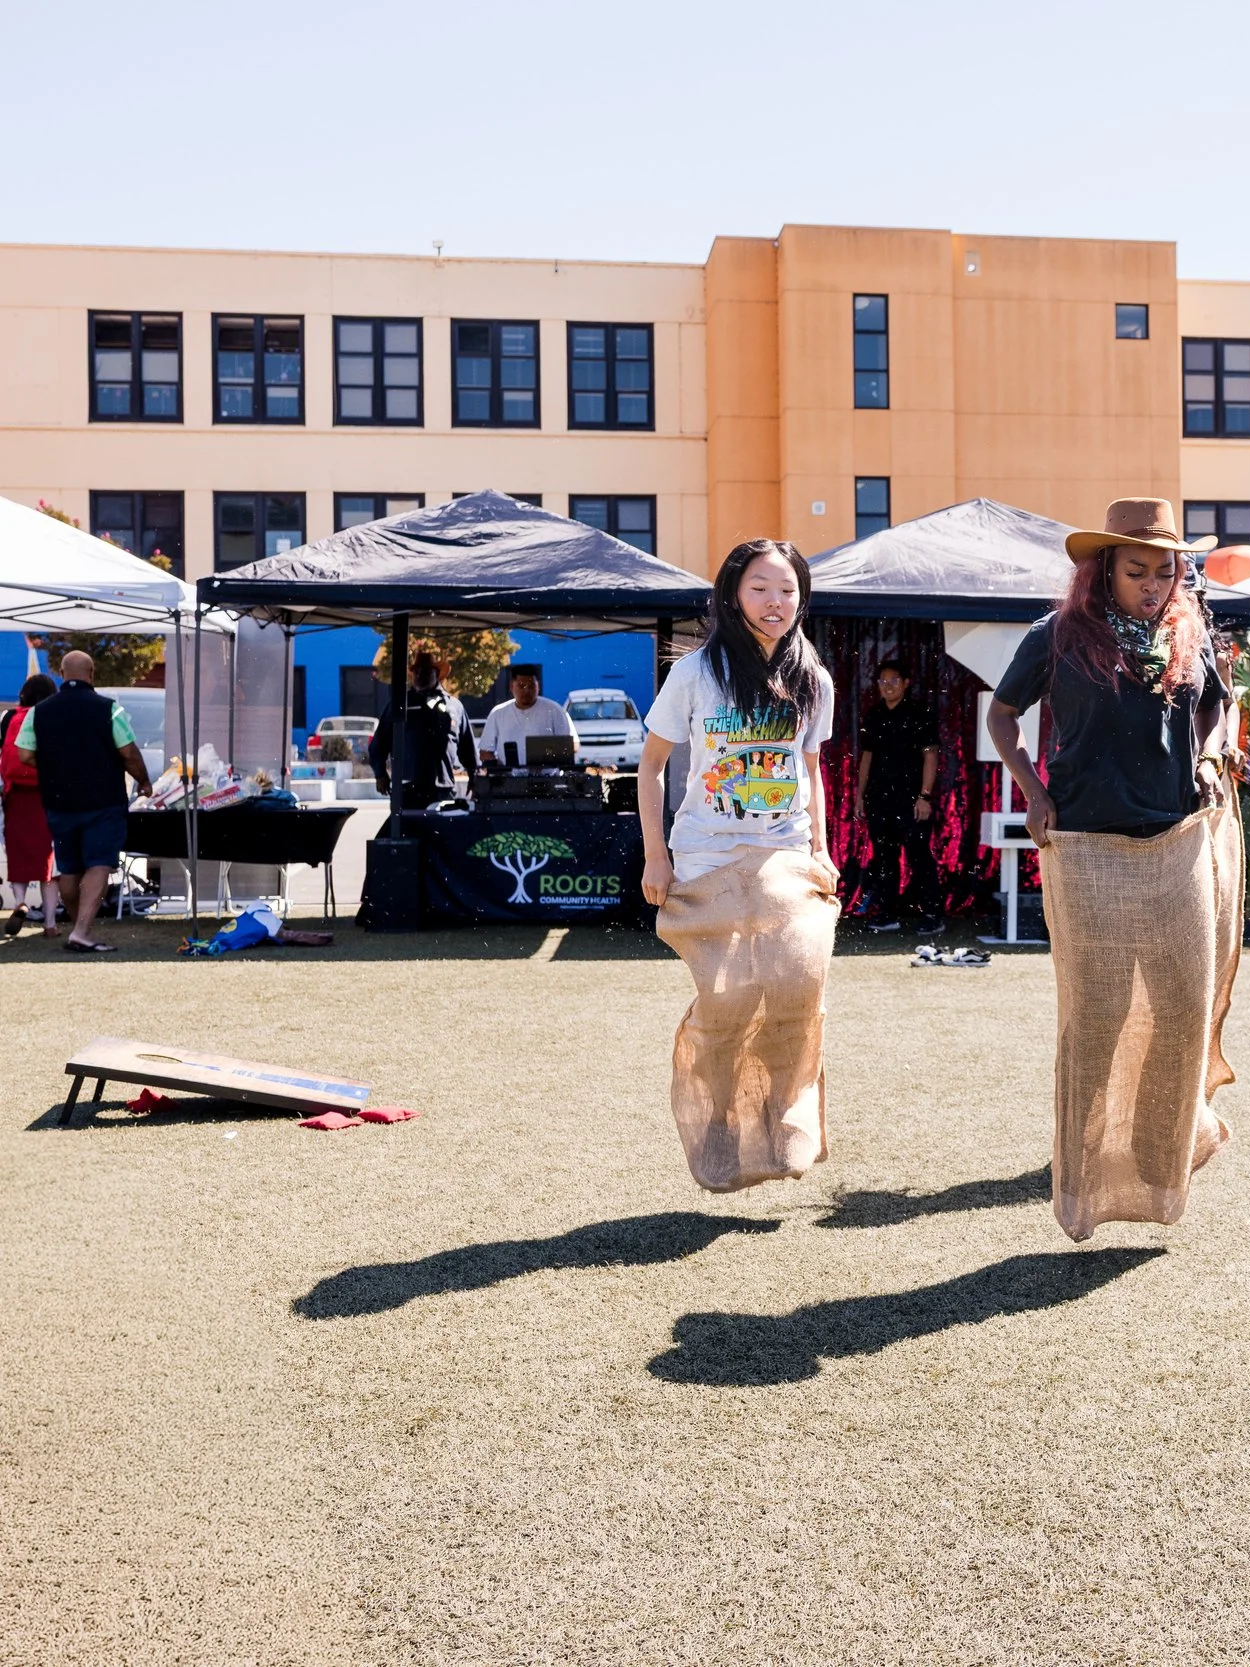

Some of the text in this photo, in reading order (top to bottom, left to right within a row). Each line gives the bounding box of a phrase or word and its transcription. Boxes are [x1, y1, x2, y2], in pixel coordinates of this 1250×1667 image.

[704, 717, 730, 733] THE
[540, 874, 620, 894] ROOTS
[540, 896, 620, 904] COMMUNITY HEALTH
